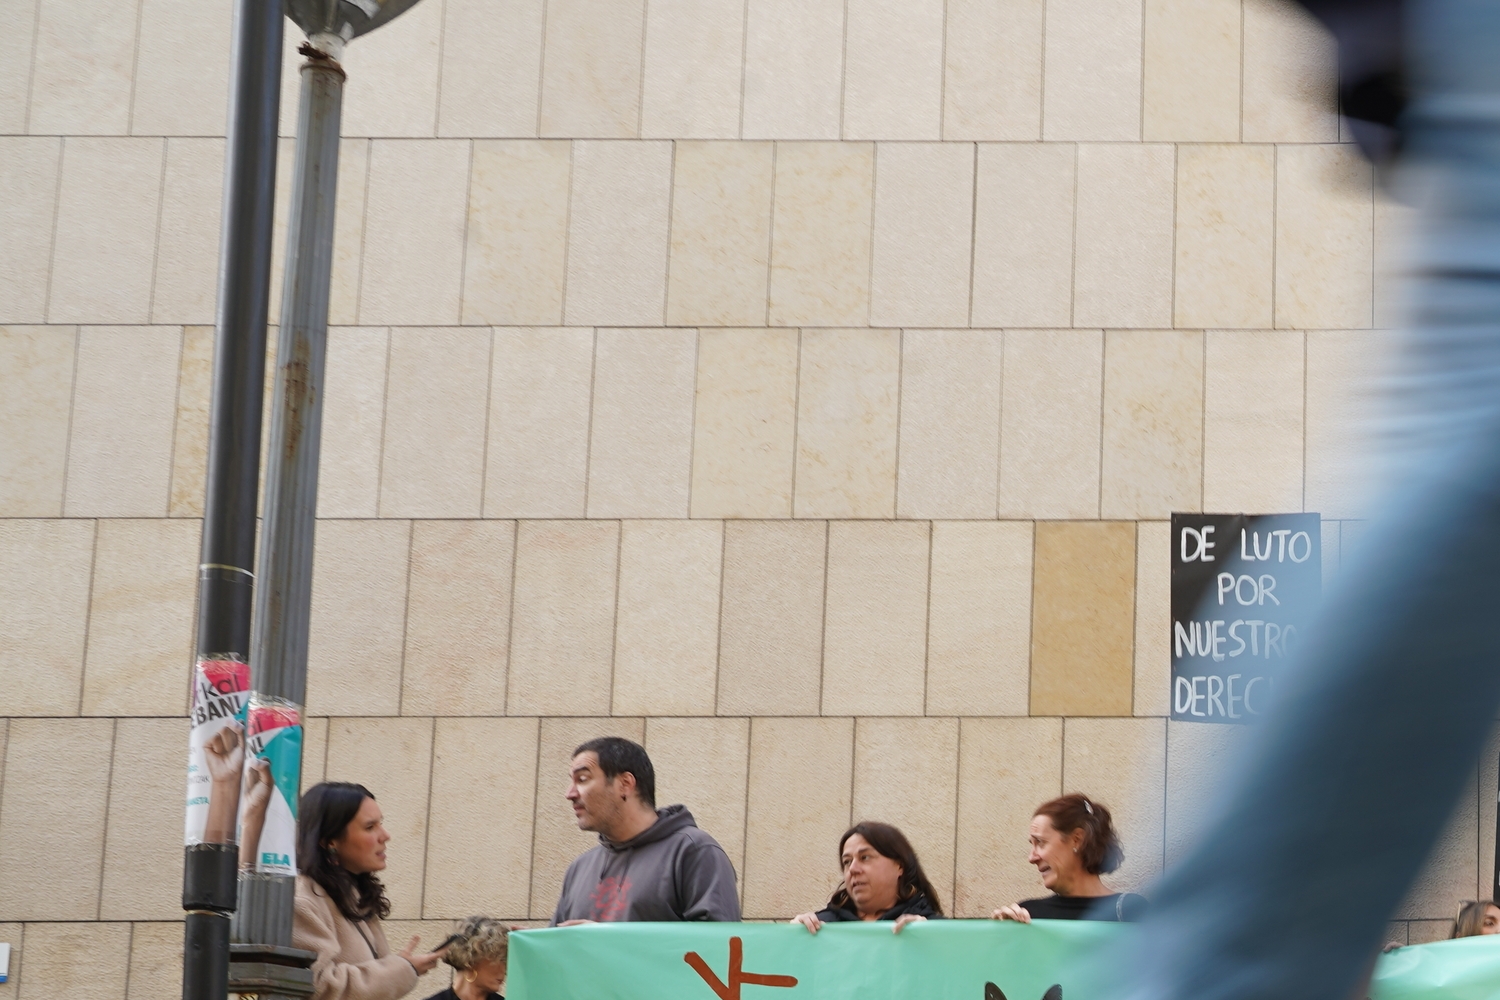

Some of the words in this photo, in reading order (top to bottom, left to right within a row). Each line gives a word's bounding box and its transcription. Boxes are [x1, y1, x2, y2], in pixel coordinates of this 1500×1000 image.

[1181, 525, 1215, 563] DE
[1240, 527, 1312, 563] LUTO
[1217, 572, 1281, 606] POR
[1174, 618, 1301, 662] NUESTRO
[1174, 673, 1275, 719] DEREC
[261, 853, 291, 866] ELA
